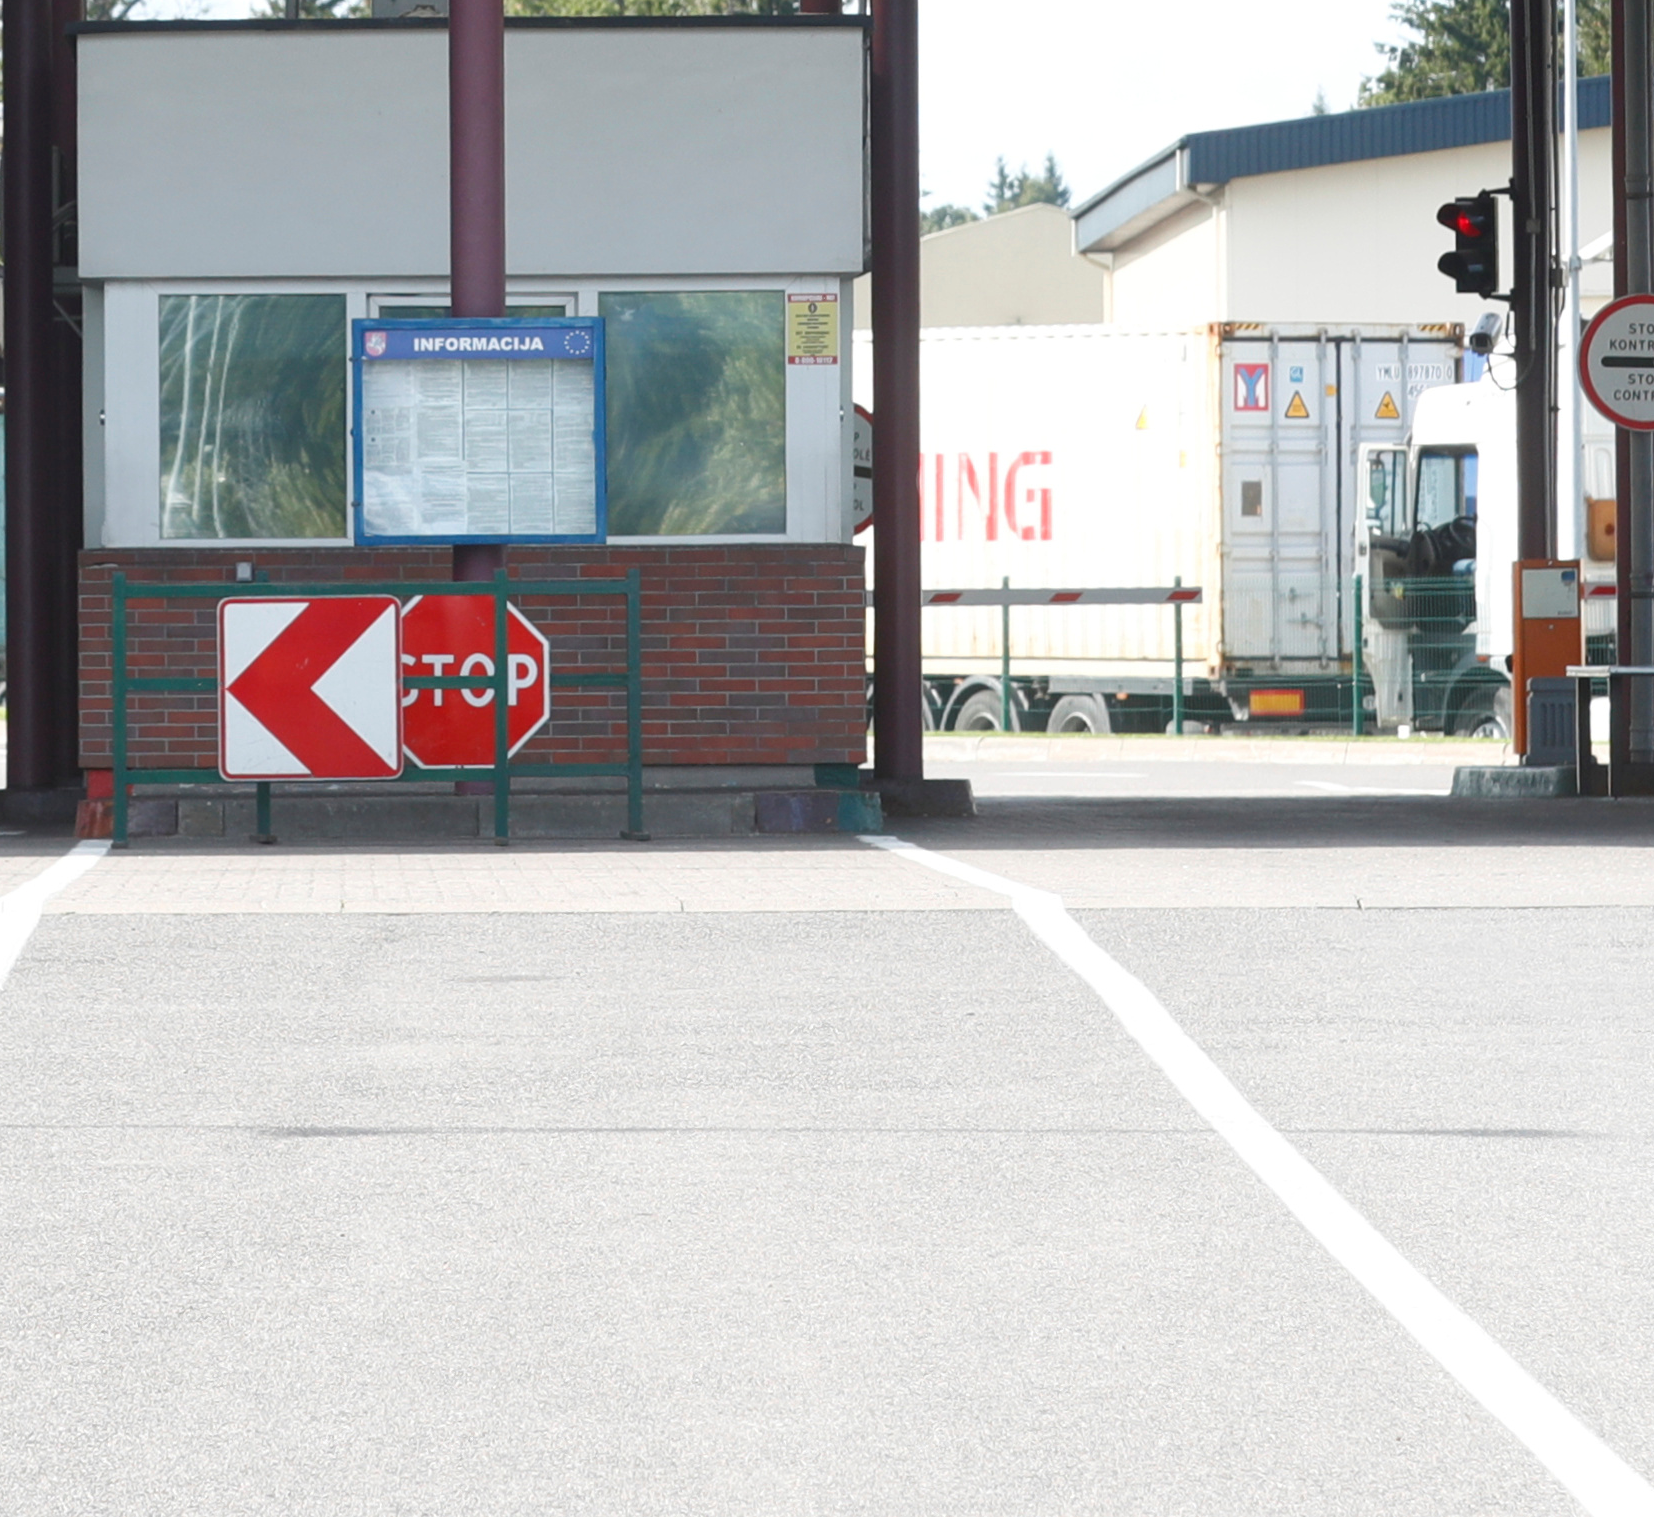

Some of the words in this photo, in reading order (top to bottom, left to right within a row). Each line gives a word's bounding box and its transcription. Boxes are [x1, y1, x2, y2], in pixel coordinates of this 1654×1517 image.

[414, 337, 543, 351] INFORMACIJA
[1377, 365, 1400, 380] YMLU
[1407, 365, 1442, 379] 897870
[920, 451, 1052, 542] ING
